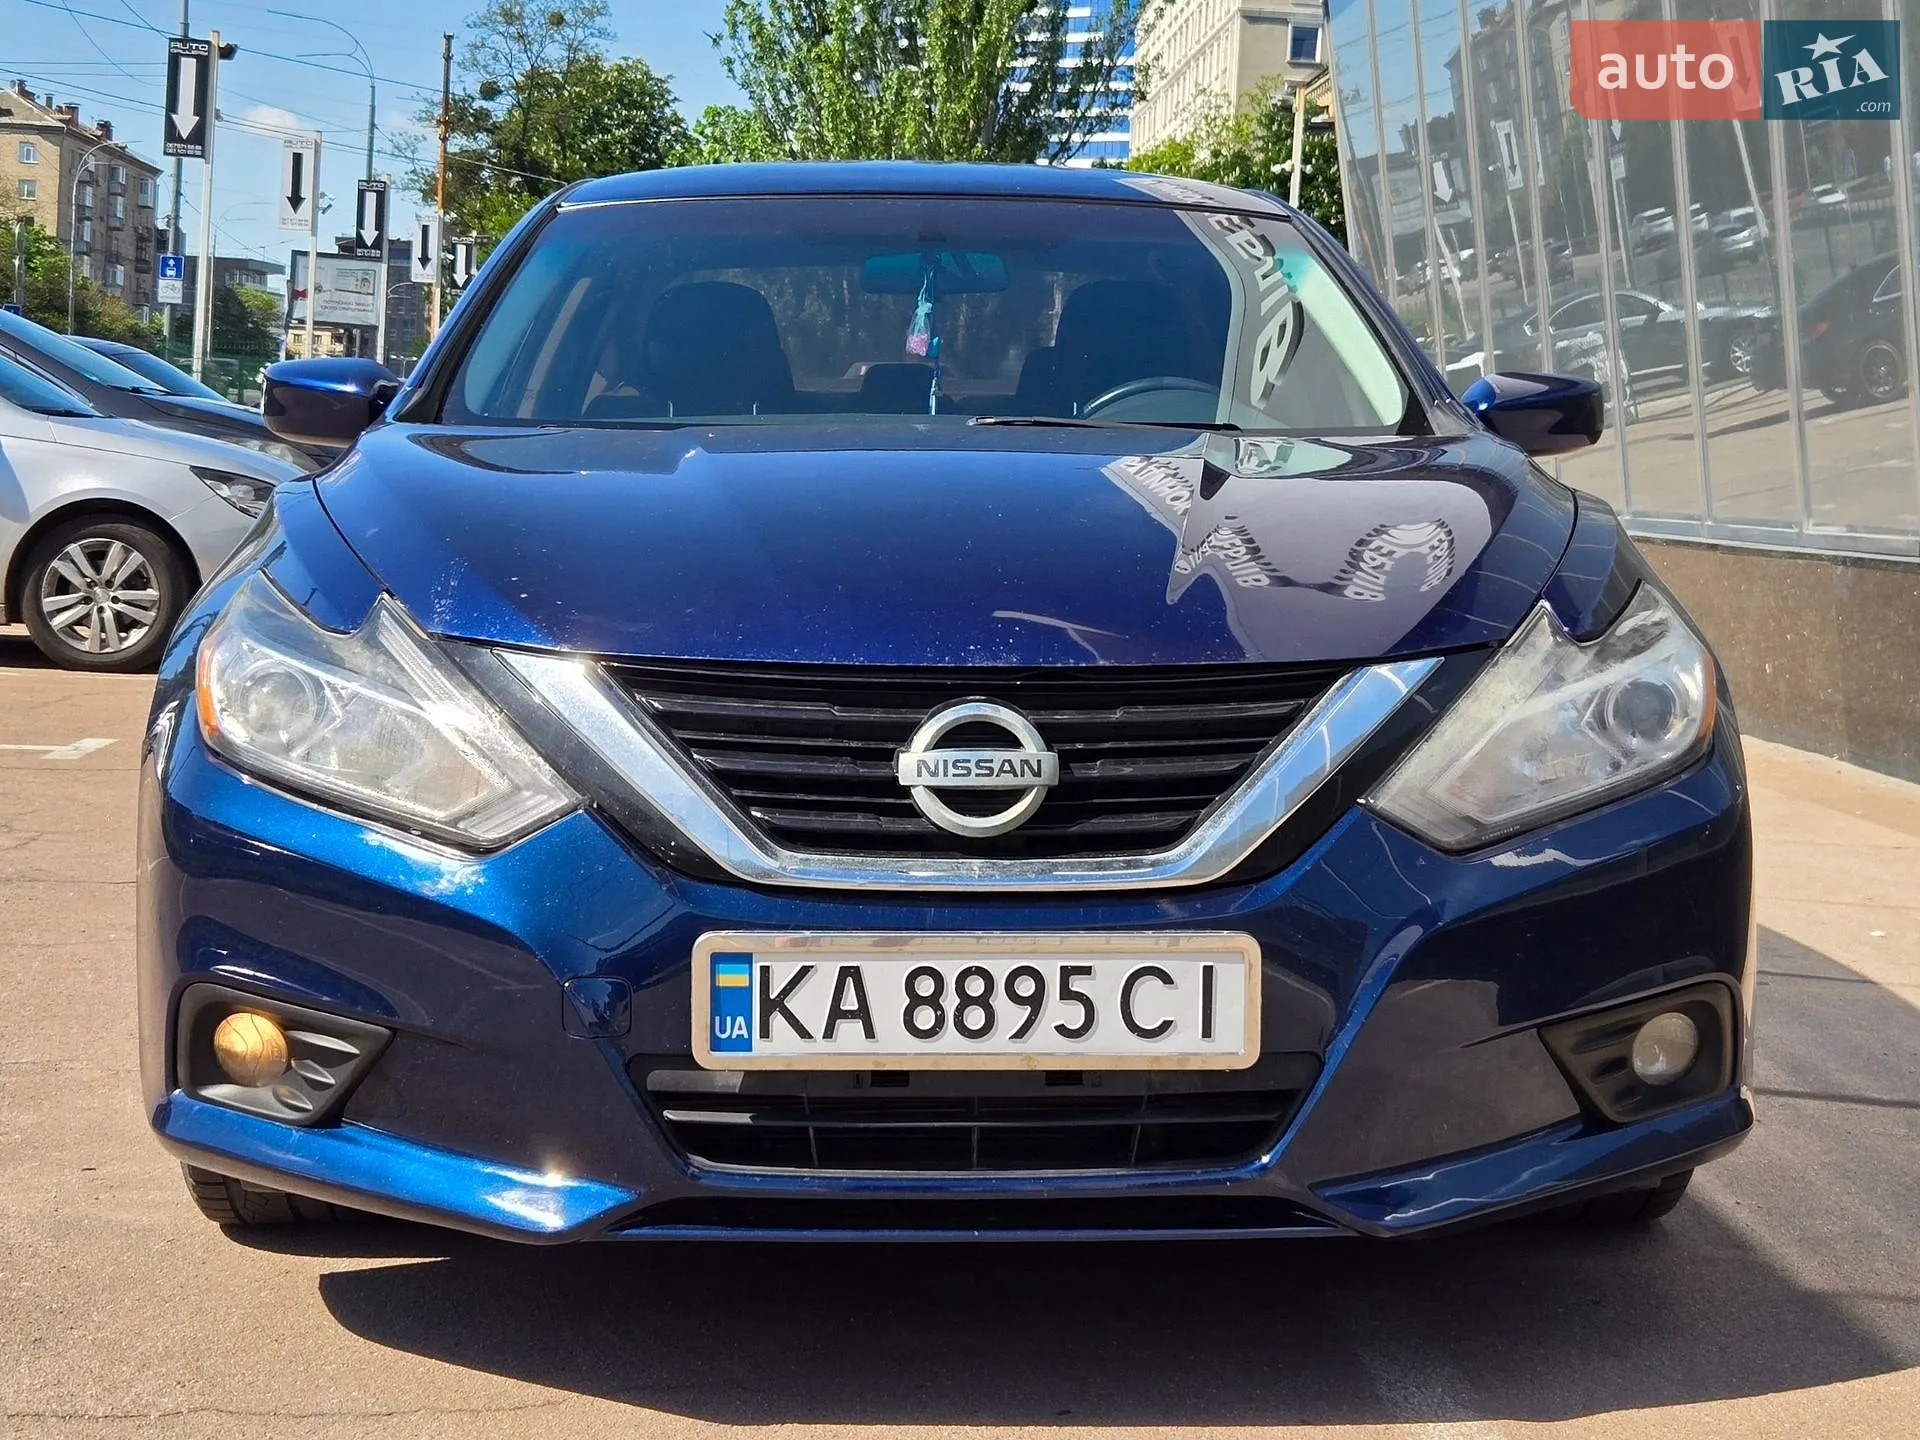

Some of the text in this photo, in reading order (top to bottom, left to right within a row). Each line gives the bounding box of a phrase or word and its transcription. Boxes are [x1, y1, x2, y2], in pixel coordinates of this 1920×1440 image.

[915, 758, 1043, 779] NISSAN
[758, 963, 1215, 1042] KA 8895 CI
[714, 1014, 749, 1040] UA
